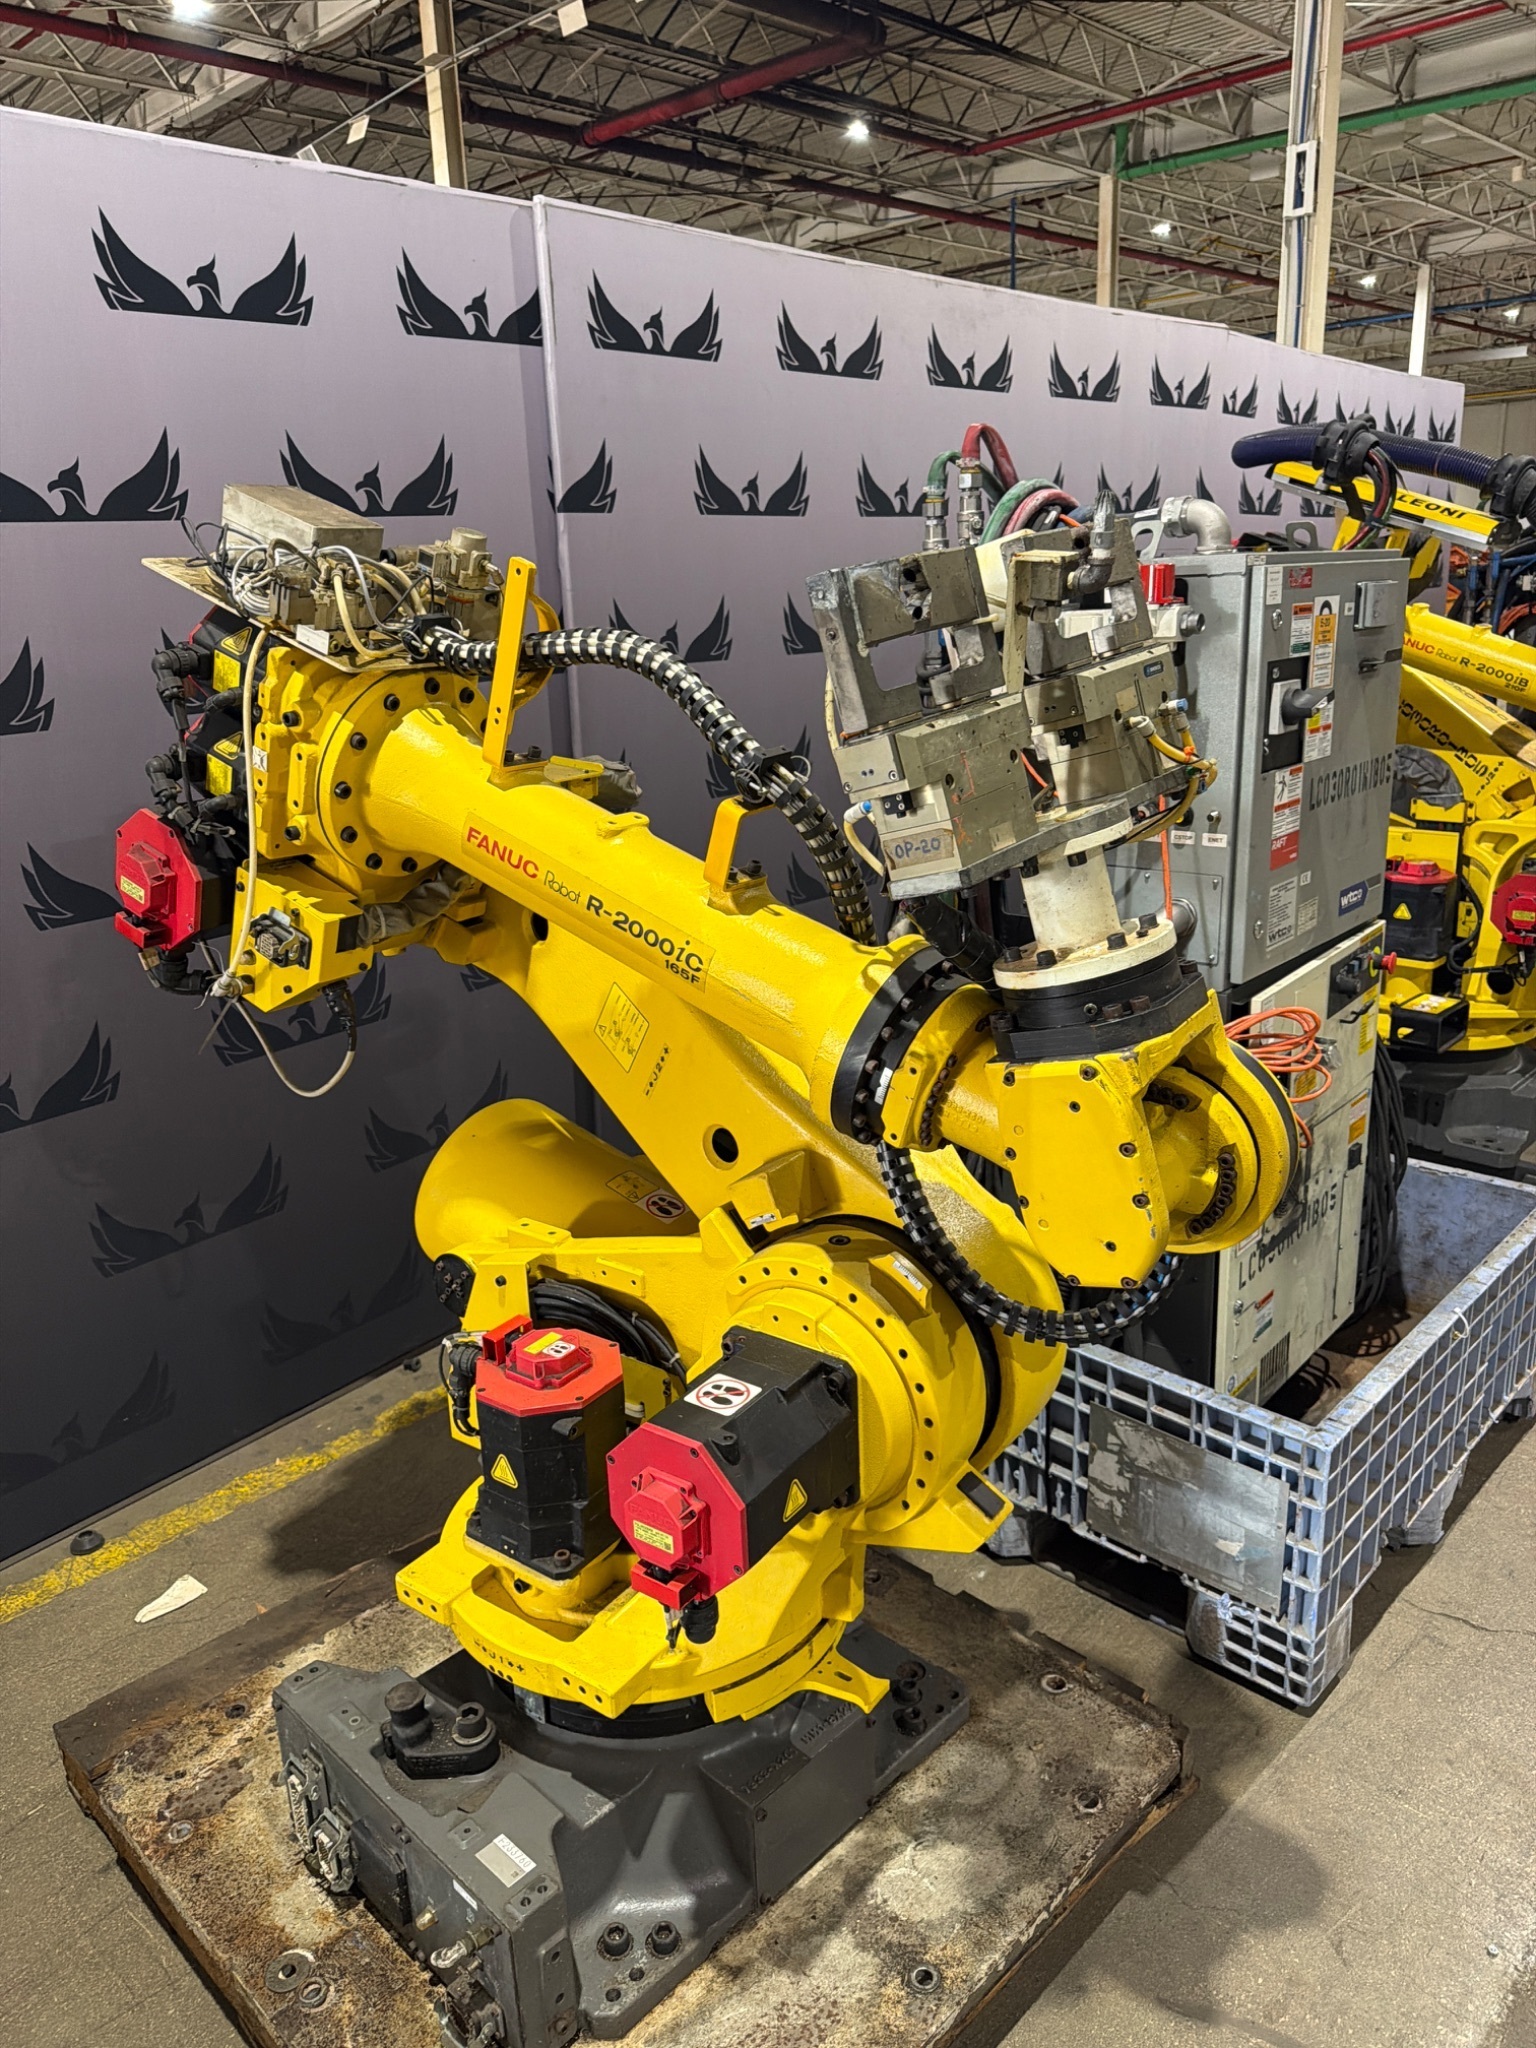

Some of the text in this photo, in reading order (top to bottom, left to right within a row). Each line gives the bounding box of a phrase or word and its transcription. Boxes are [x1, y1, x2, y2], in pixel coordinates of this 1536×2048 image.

[1397, 494, 1467, 519] LEONI
[1403, 637, 1435, 654] NUC
[895, 837, 940, 859] OP-20
[466, 827, 704, 973] FANUC Robot R-2000iC
[664, 959, 701, 985] 165F
[498, 1836, 532, 1868] F233760
